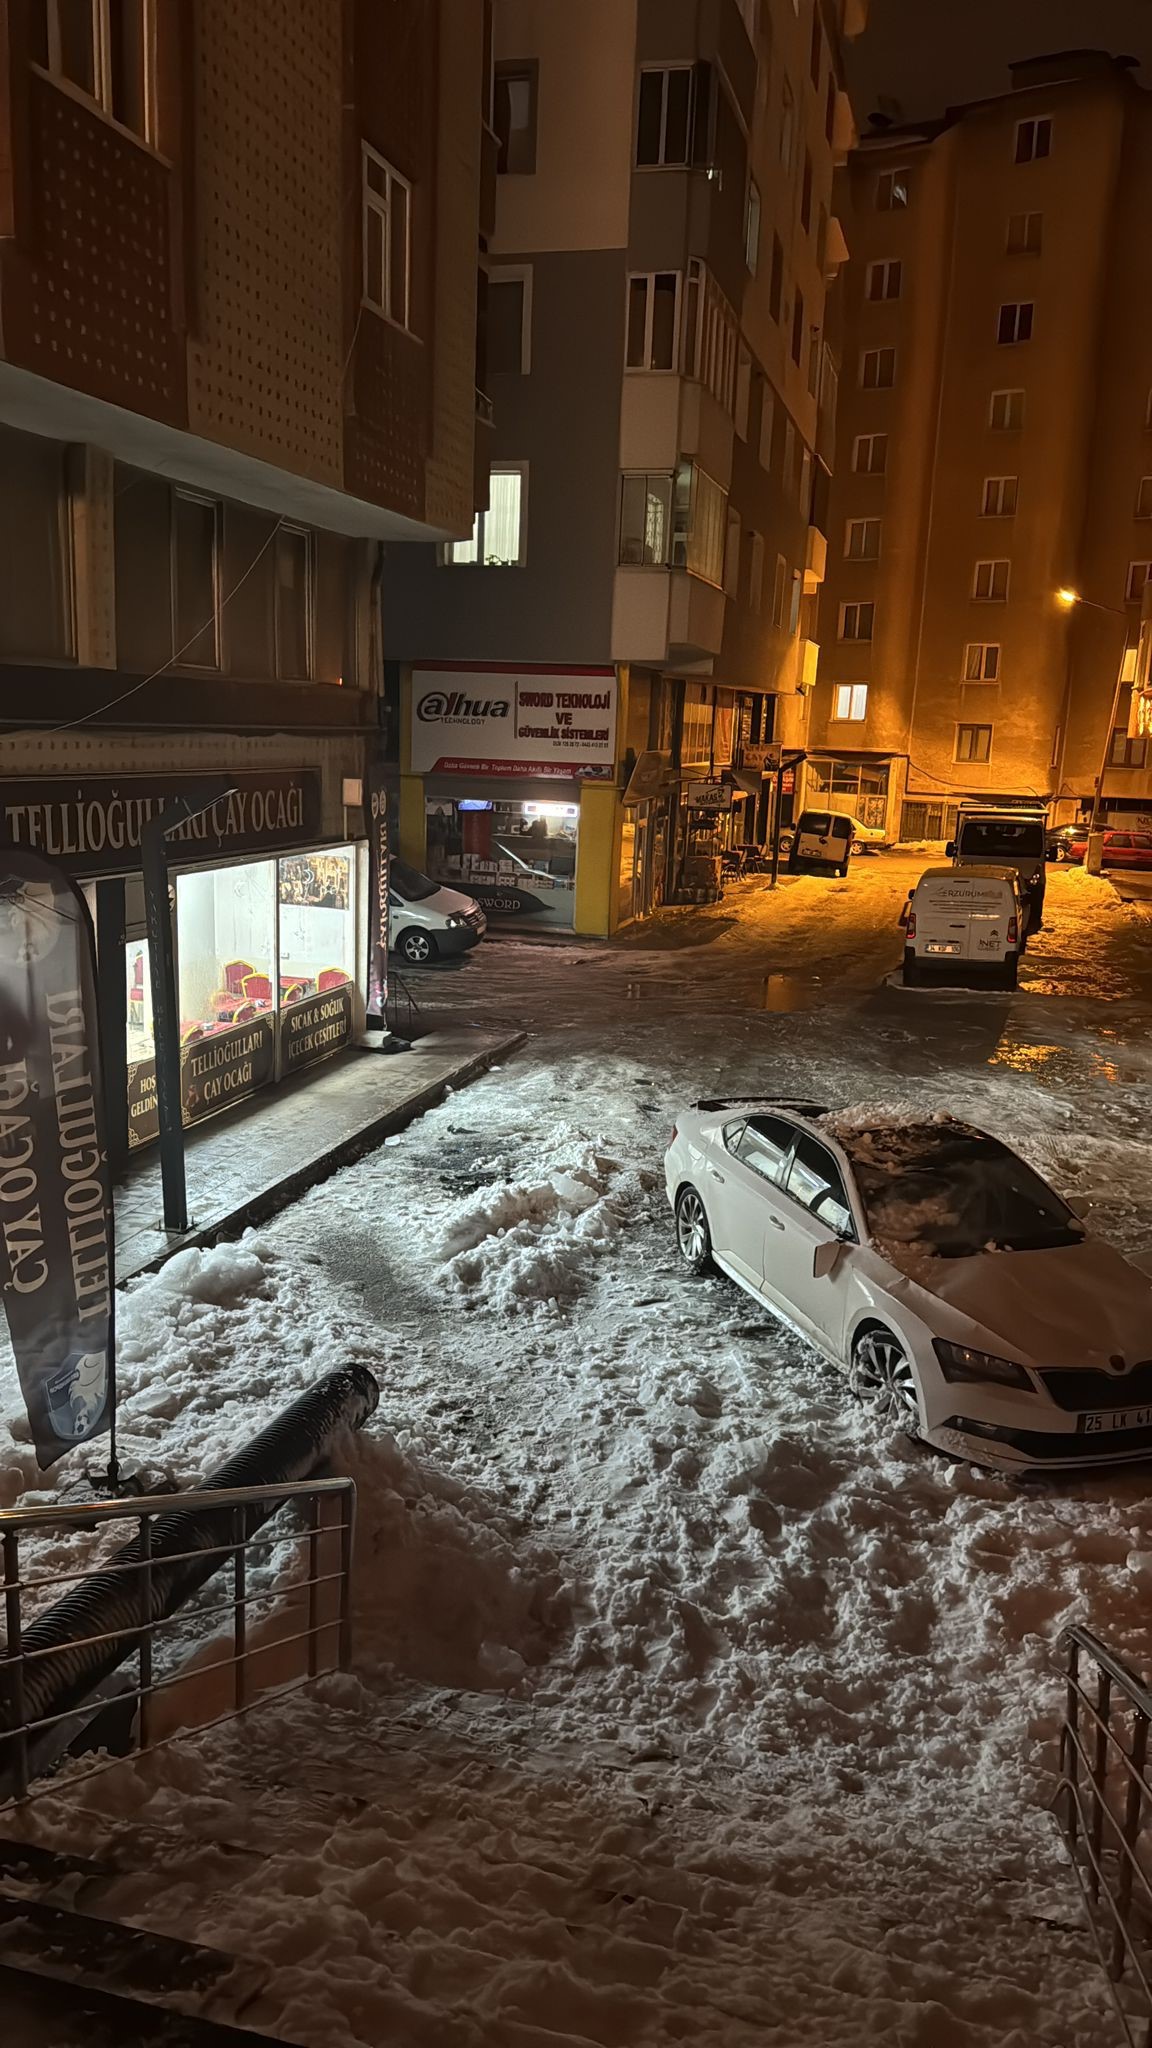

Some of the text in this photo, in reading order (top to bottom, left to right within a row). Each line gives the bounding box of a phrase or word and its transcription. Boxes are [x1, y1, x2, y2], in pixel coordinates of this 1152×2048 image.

[519, 691, 611, 710] SWORD TEKNOLOJİ
[441, 716, 486, 726] TECHNOLOGY
[556, 713, 574, 726] VE
[518, 725, 609, 741] GÜVENLİK SİSTEMLERİ
[251, 782, 304, 832] OCAĞI
[477, 897, 521, 910] SWORD
[290, 996, 345, 1034] SICAK & SOĞUK
[288, 1018, 347, 1060] İÇECEK ÇEŞİTLERİ
[190, 1030, 264, 1077] TELLİOĞULLARI
[140, 1075, 157, 1094] HOŞ
[203, 1061, 253, 1105] ÇAY OCAĞI
[1086, 1415, 1102, 1432] 25
[1112, 1413, 1127, 1429] LK
